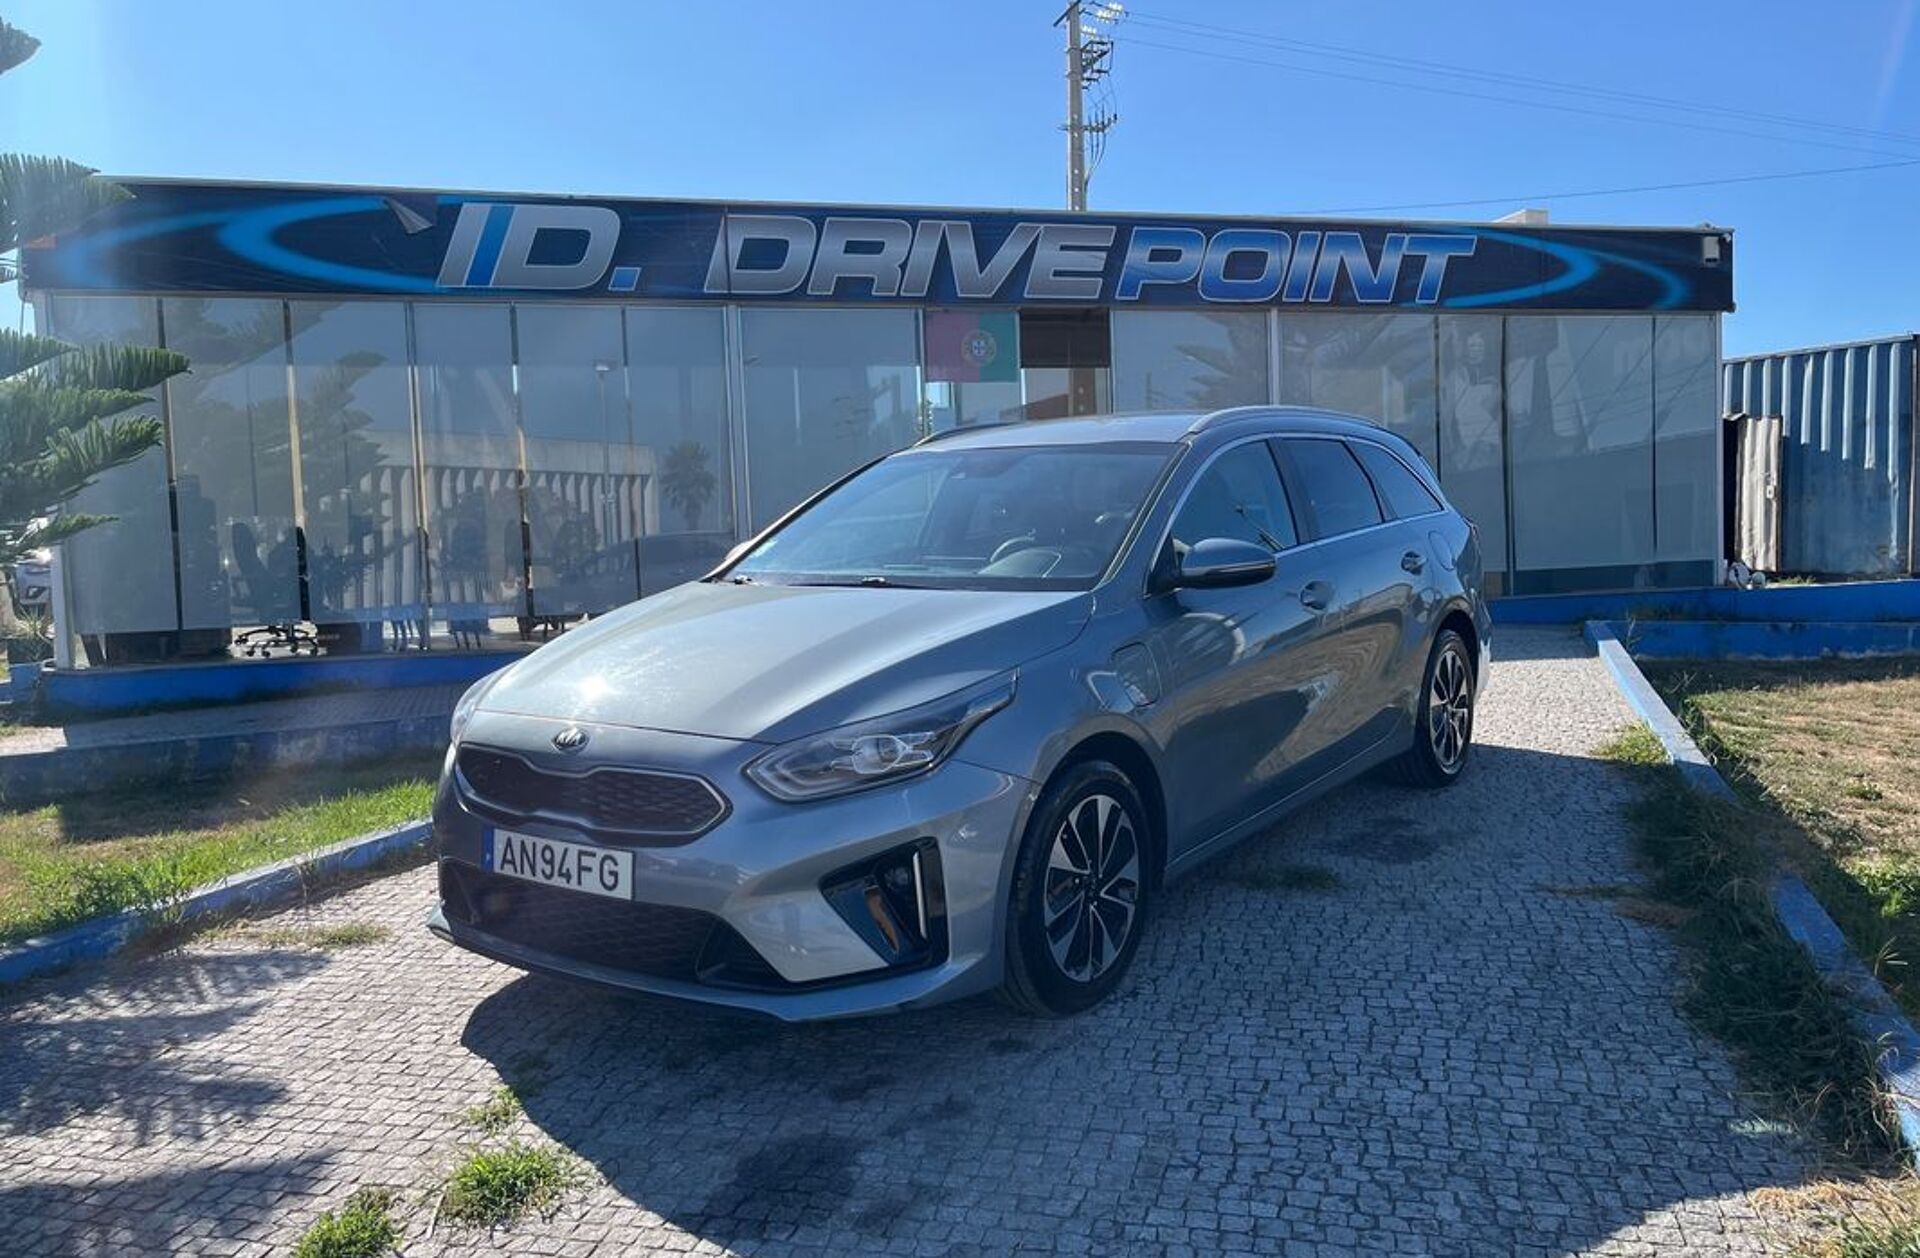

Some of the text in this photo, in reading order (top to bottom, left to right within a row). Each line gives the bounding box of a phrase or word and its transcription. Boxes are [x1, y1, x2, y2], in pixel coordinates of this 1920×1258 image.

[703, 213, 1116, 300] DRIVE
[1115, 225, 1477, 305] POINT
[500, 835, 620, 892] AN94FG
